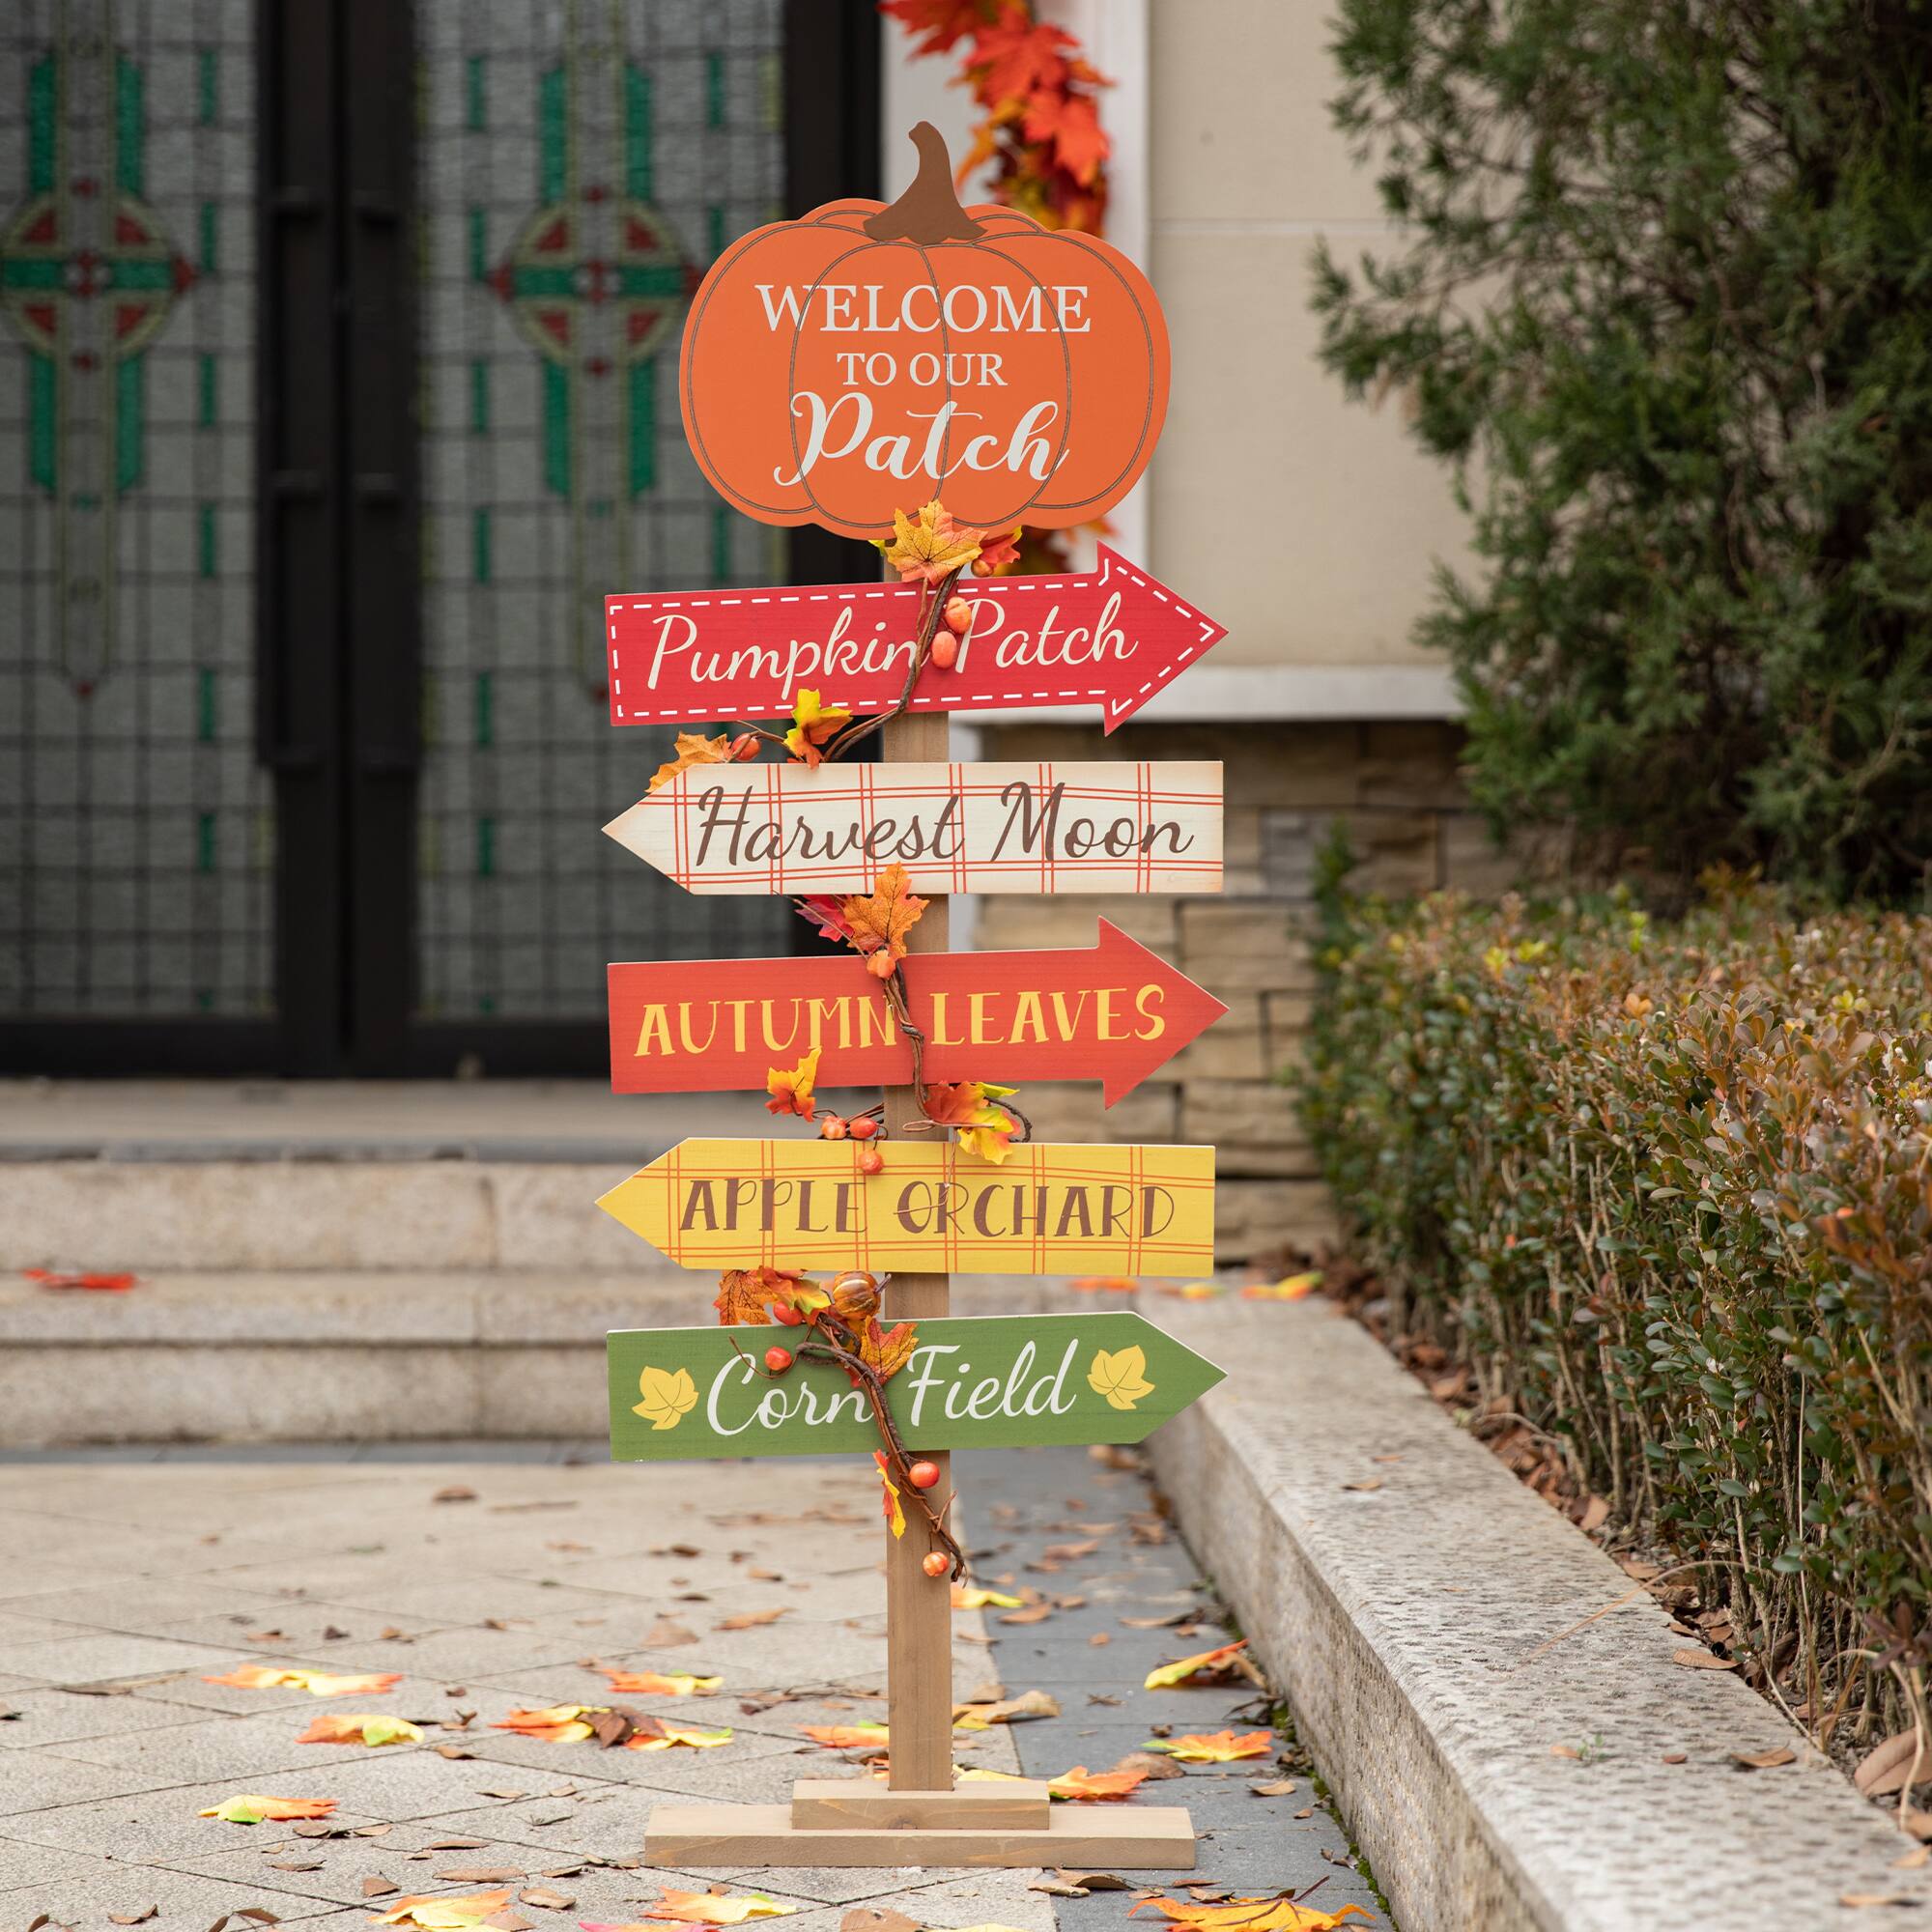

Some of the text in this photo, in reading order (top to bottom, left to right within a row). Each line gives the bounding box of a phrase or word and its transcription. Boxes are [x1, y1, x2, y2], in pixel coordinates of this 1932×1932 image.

[754, 284, 1091, 333] WELCOME
[837, 352, 1009, 387] TO OUR
[773, 390, 1069, 486] Patch
[647, 590, 1138, 700] Pumpkin Patch
[696, 781, 1195, 867] Harvest Moon
[634, 983, 1166, 1057] AUTUMN LEAVES
[680, 1177, 1176, 1238] APPLE ORCHARD
[706, 1337, 1080, 1435] Corn Field
